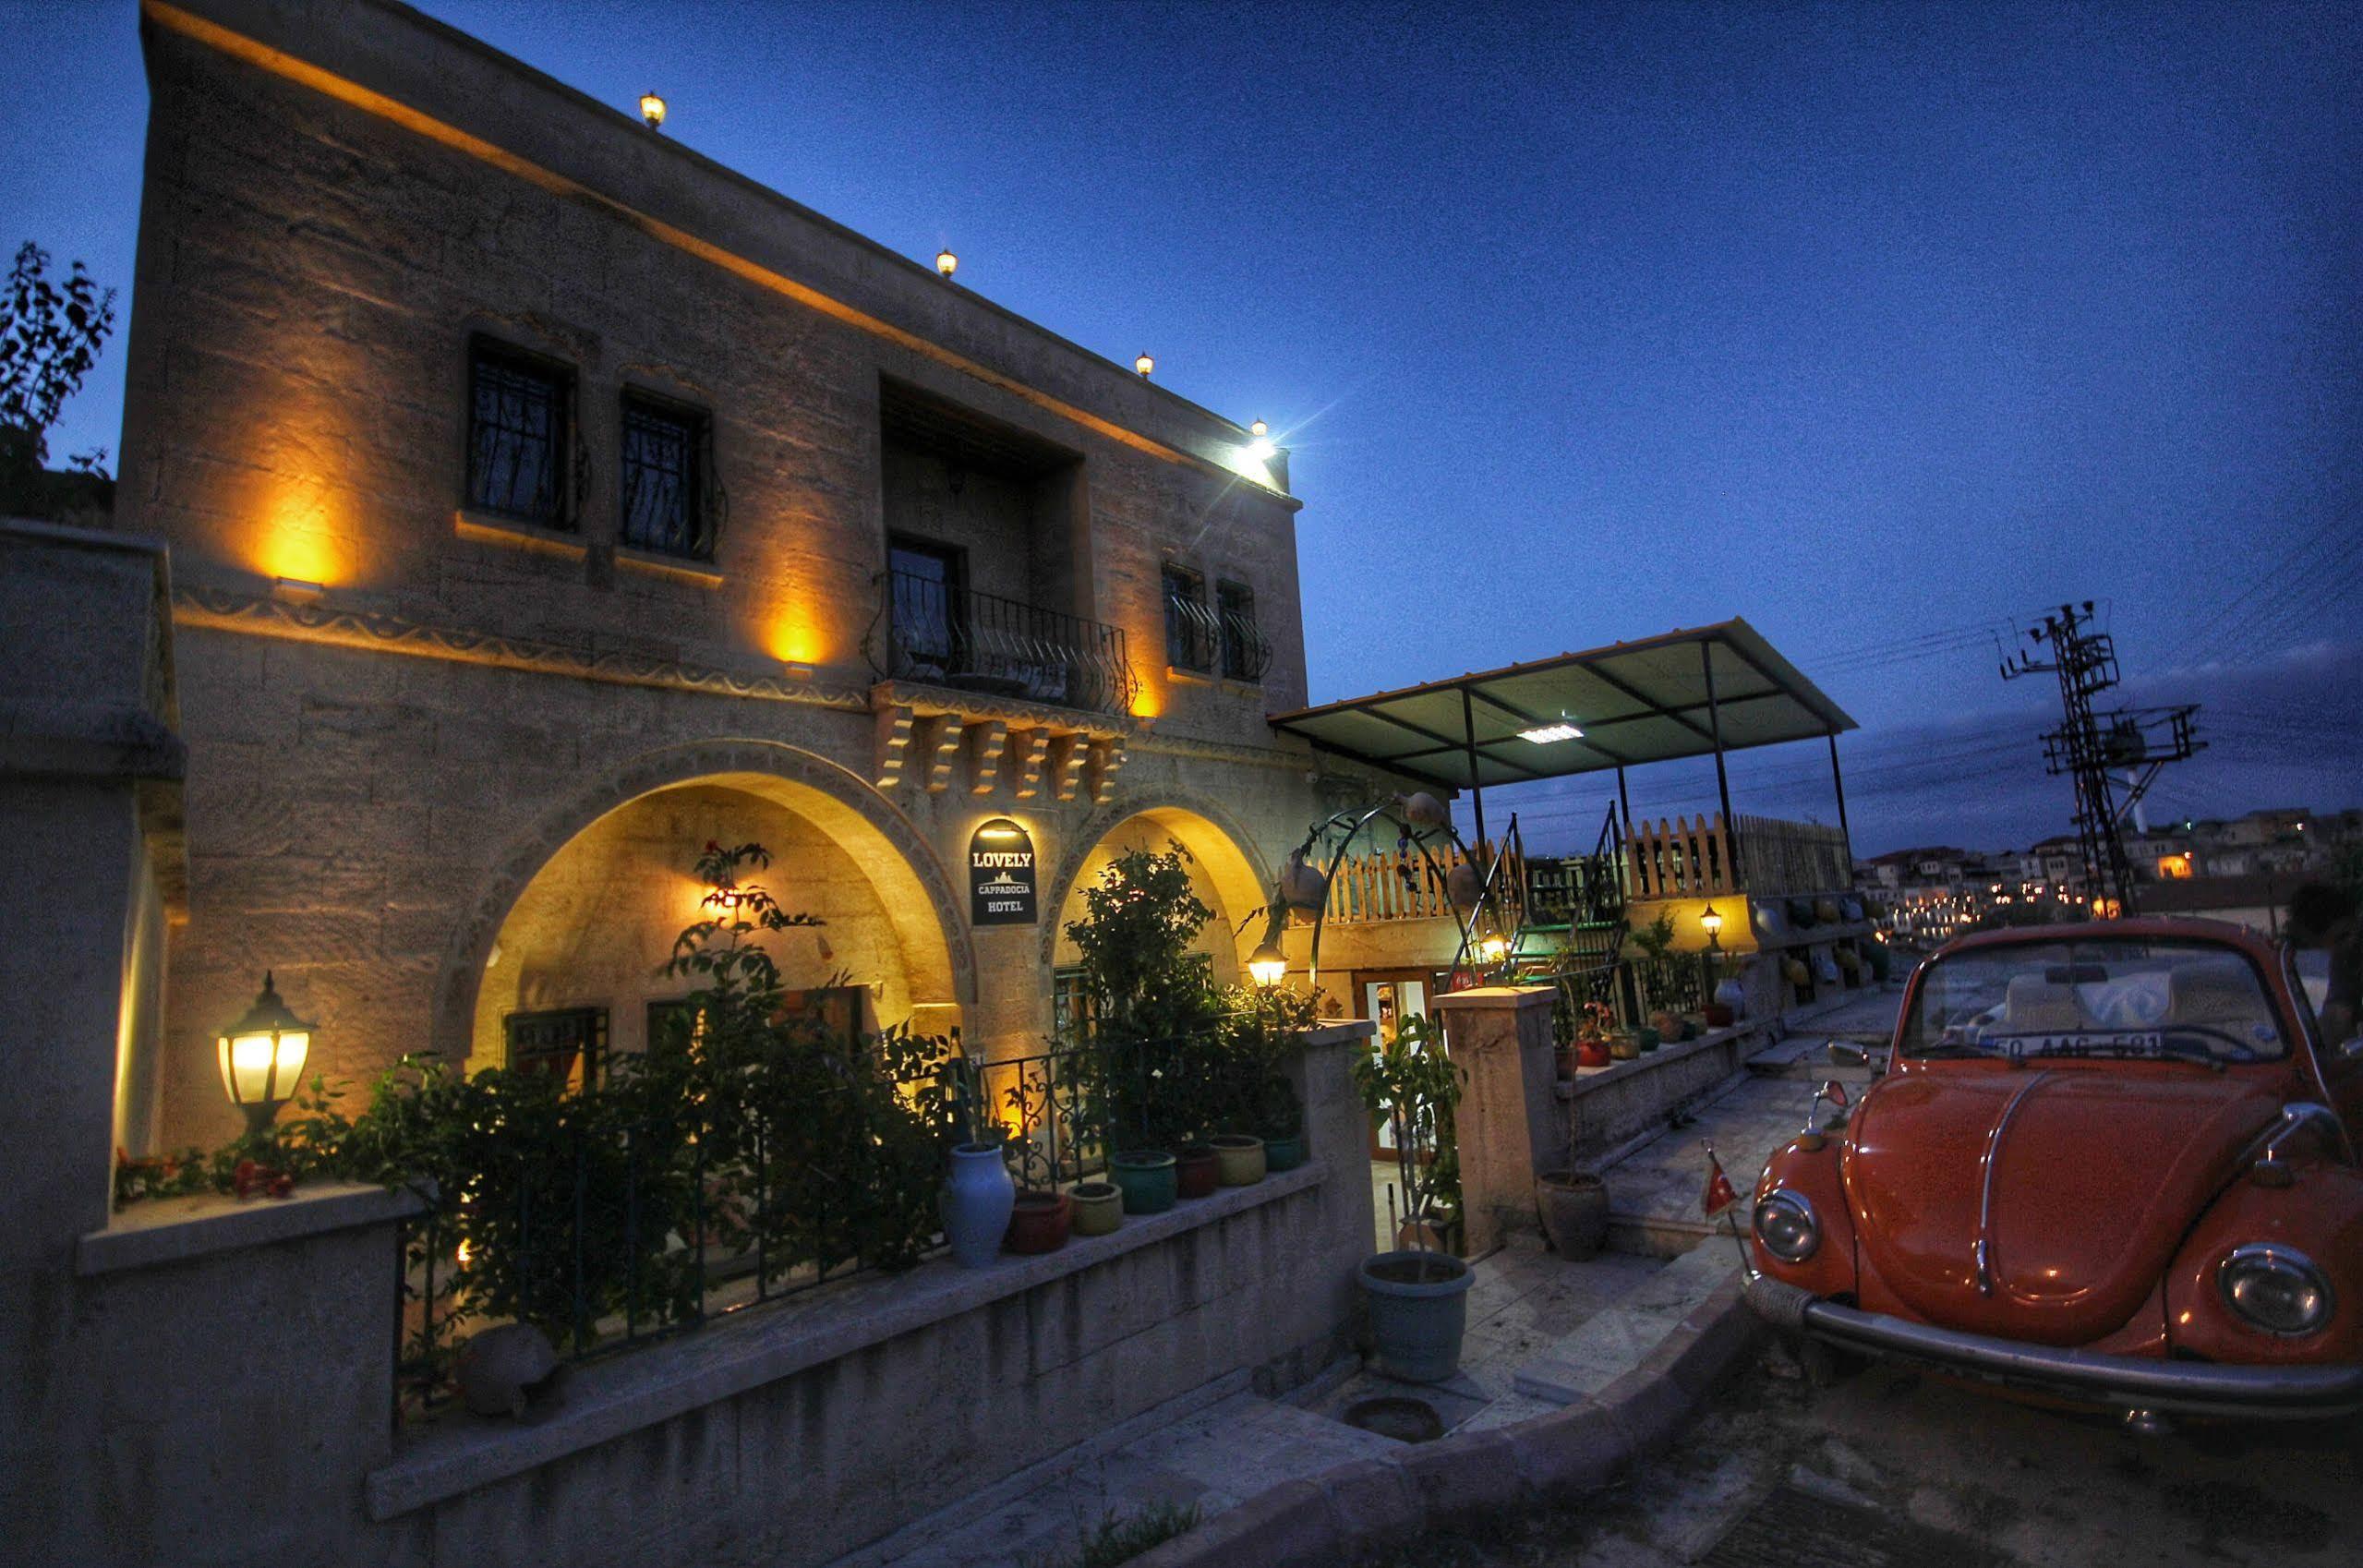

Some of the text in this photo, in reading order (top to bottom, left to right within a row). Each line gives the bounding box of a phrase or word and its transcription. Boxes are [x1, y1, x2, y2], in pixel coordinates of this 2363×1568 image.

[973, 852, 1031, 867] LOVELY
[979, 886, 1030, 894] CAPPADOCIA
[988, 901, 1023, 912] HOTEL
